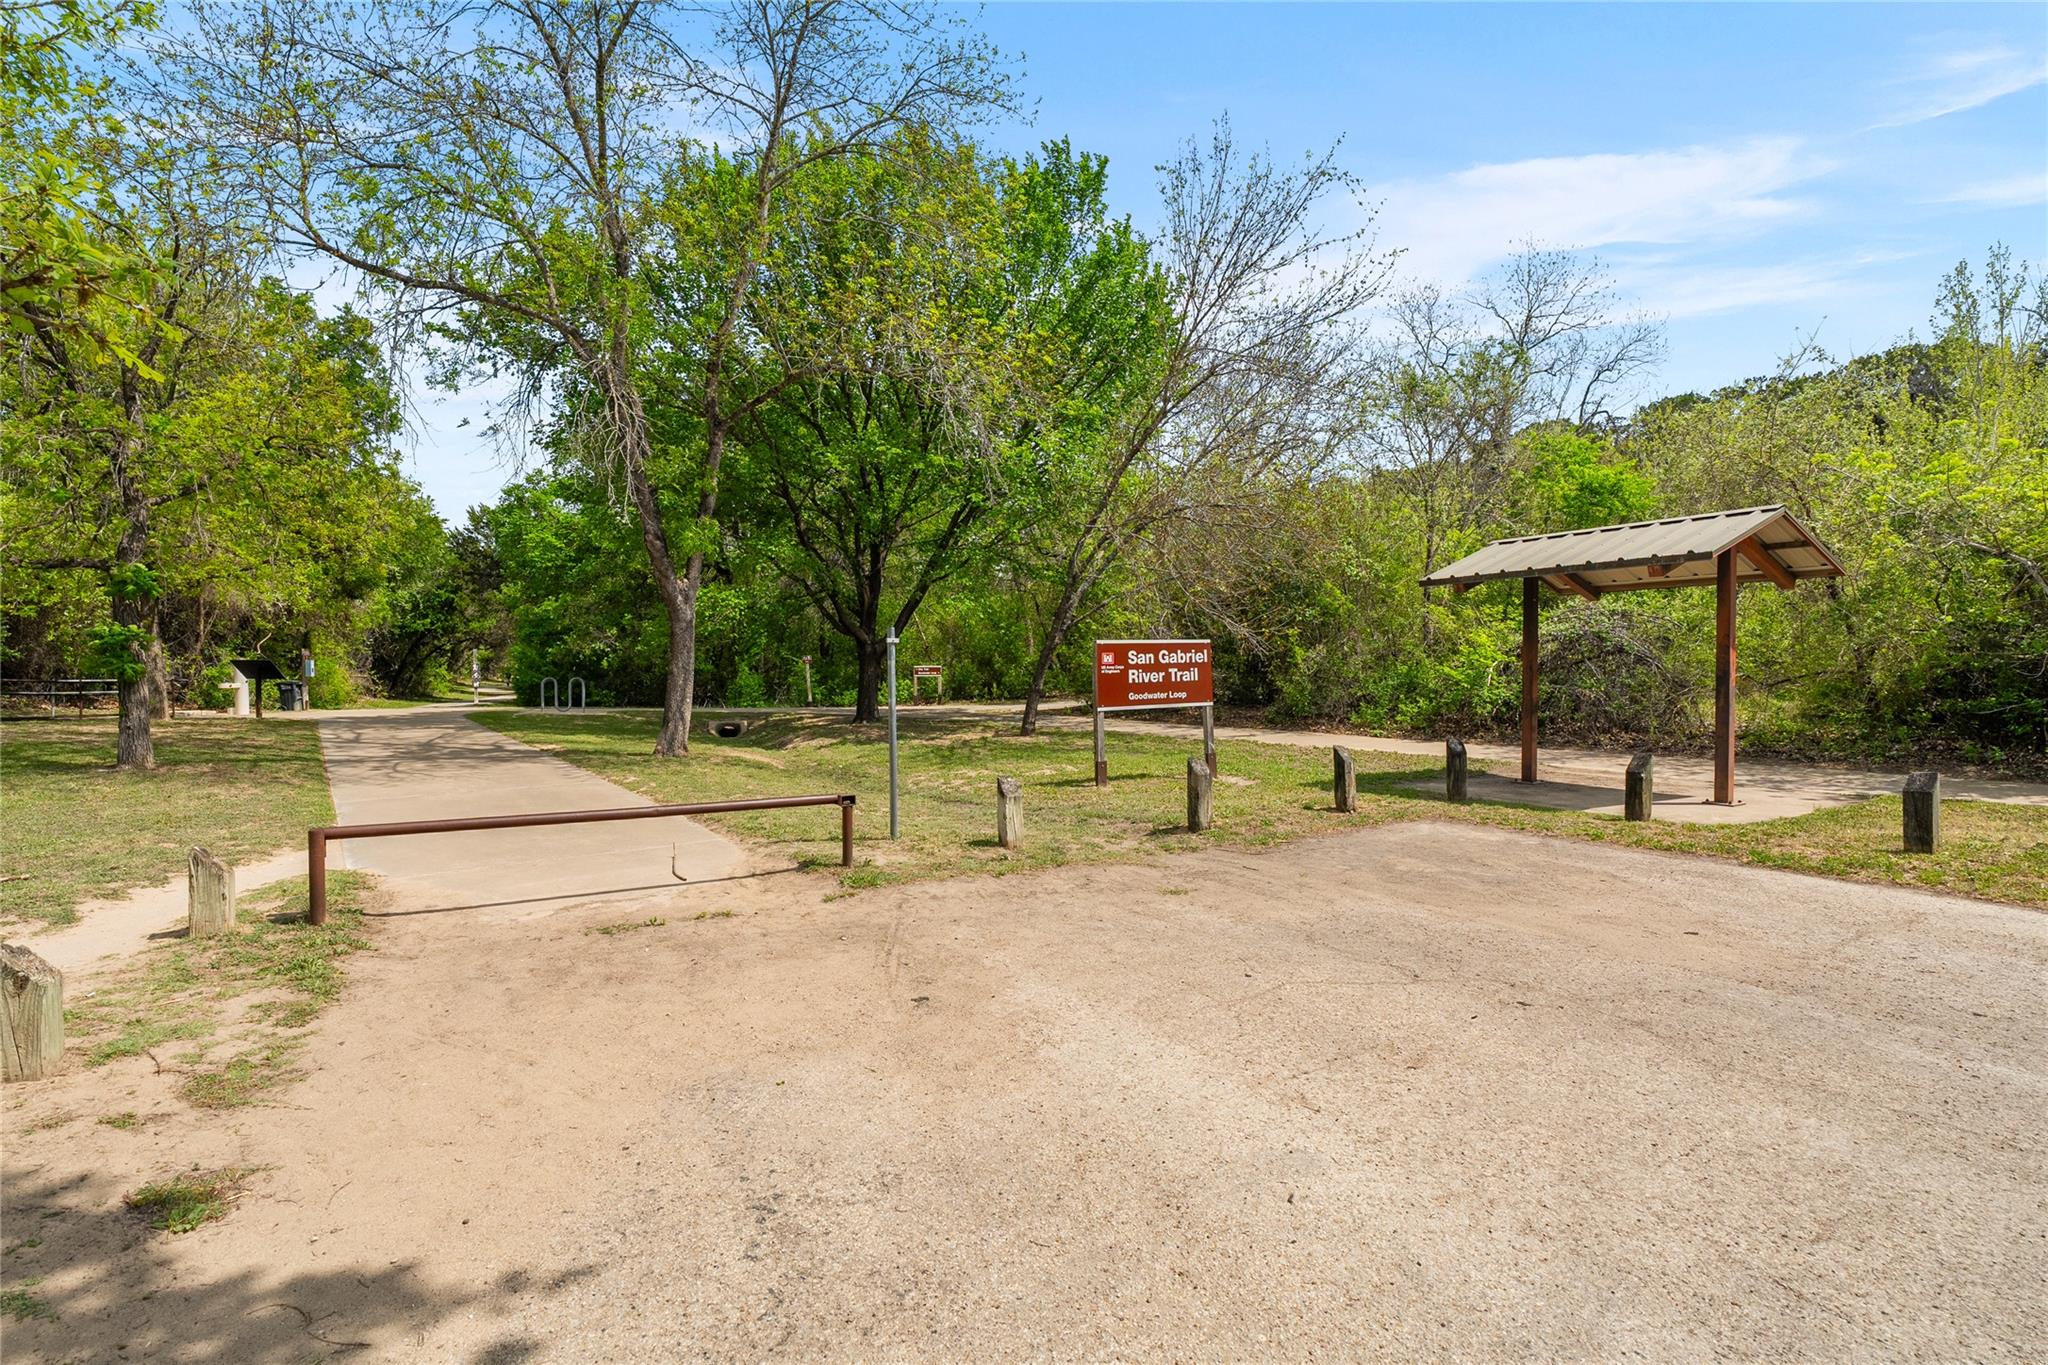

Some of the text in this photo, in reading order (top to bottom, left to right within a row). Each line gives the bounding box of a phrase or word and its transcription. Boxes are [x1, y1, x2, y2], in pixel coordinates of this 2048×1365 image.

[1128, 649, 1208, 665] San Gabriel
[1128, 667, 1199, 684] River Trail
[1128, 691, 1187, 700] Goodwater Loop
